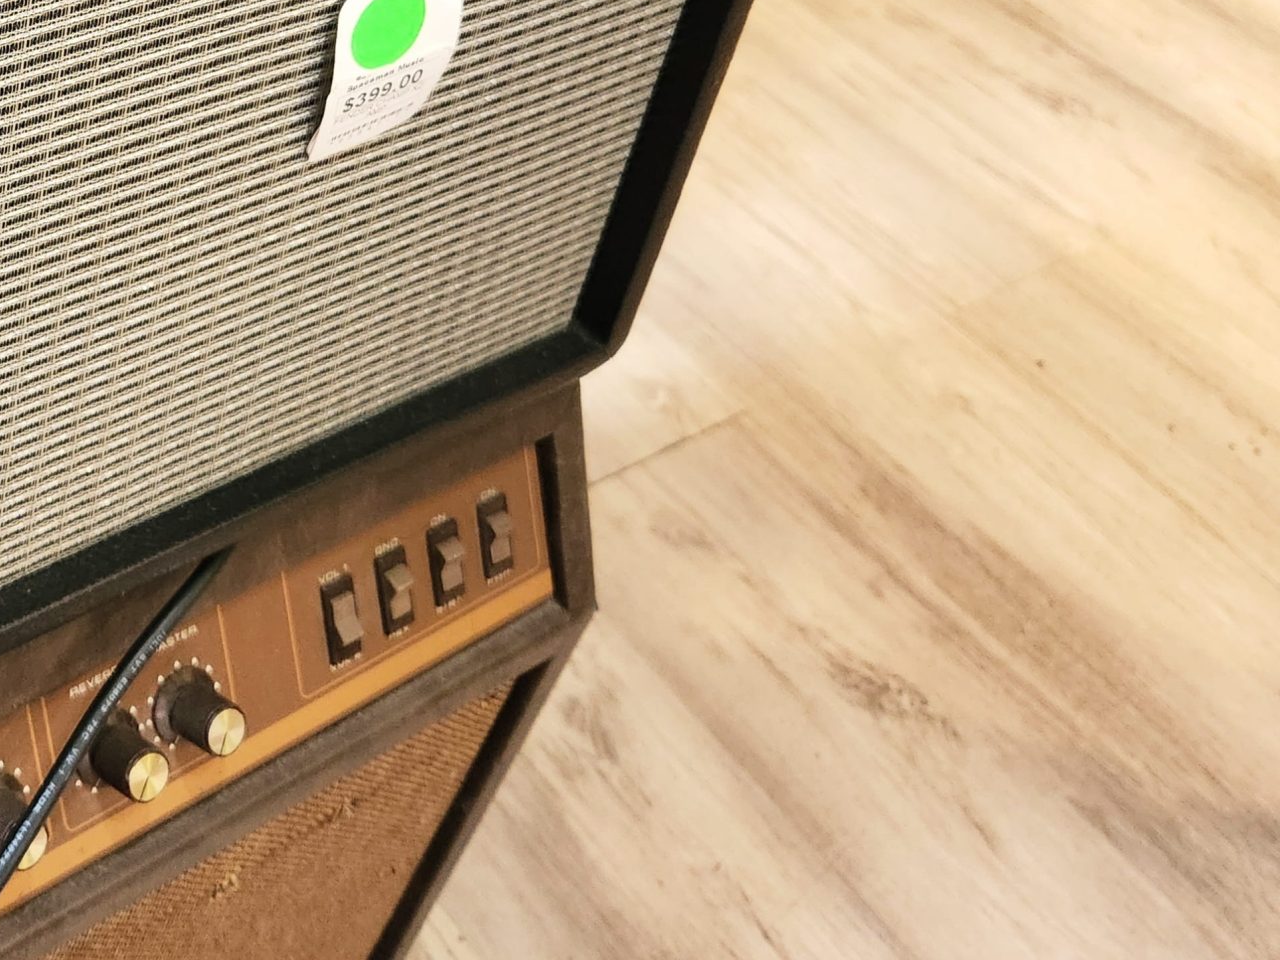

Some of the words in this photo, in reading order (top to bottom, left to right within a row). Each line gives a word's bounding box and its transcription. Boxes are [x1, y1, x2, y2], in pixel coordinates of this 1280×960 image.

[342, 68, 424, 113] $399.00
[318, 569, 340, 586] VOL
[155, 624, 200, 653] ASTER
[69, 663, 117, 698] REVER
